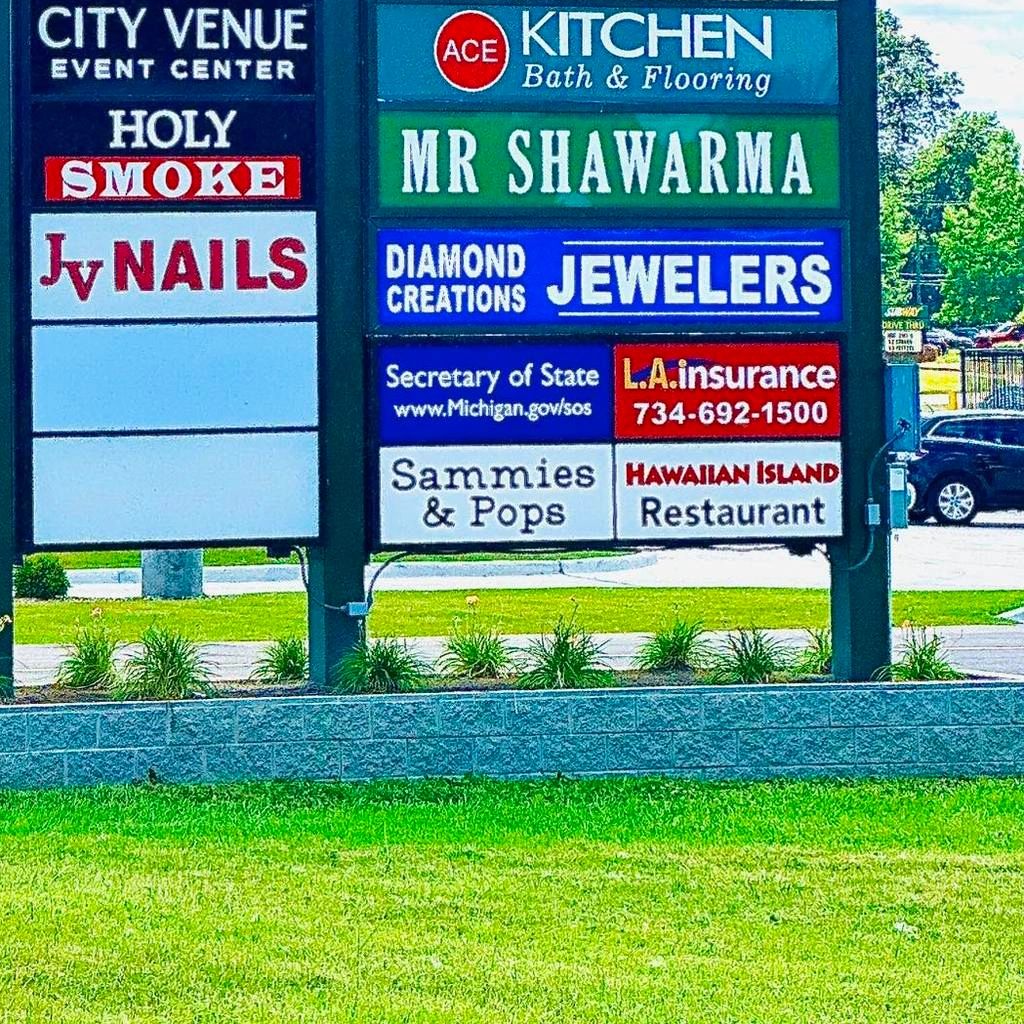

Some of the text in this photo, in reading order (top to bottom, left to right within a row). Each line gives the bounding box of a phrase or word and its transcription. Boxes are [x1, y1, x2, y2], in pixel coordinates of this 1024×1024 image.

[39, 6, 308, 51] CITY VENUE
[522, 10, 773, 60] KITCHEN
[442, 39, 498, 63] ACE
[51, 58, 296, 80] EVENT CENTER
[522, 64, 771, 97] Bath & Flooring
[108, 109, 237, 148] HOLY
[401, 128, 812, 195] MR SHAWARMA
[61, 160, 286, 198] SMOKE
[113, 238, 308, 291] NAILS
[386, 244, 526, 279] DIAMOND
[546, 254, 833, 306] JEWELERS
[386, 284, 526, 313] CREATIONS
[386, 363, 600, 394] Secretary of State
[394, 398, 592, 422] www.Michigan.gov/sos
[633, 401, 829, 426] 734-692-1500
[391, 458, 596, 492] Sammies
[626, 460, 840, 486] HAWAIIAN ISLAND
[422, 497, 566, 534] & Pops
[640, 496, 826, 526] Restaurant
